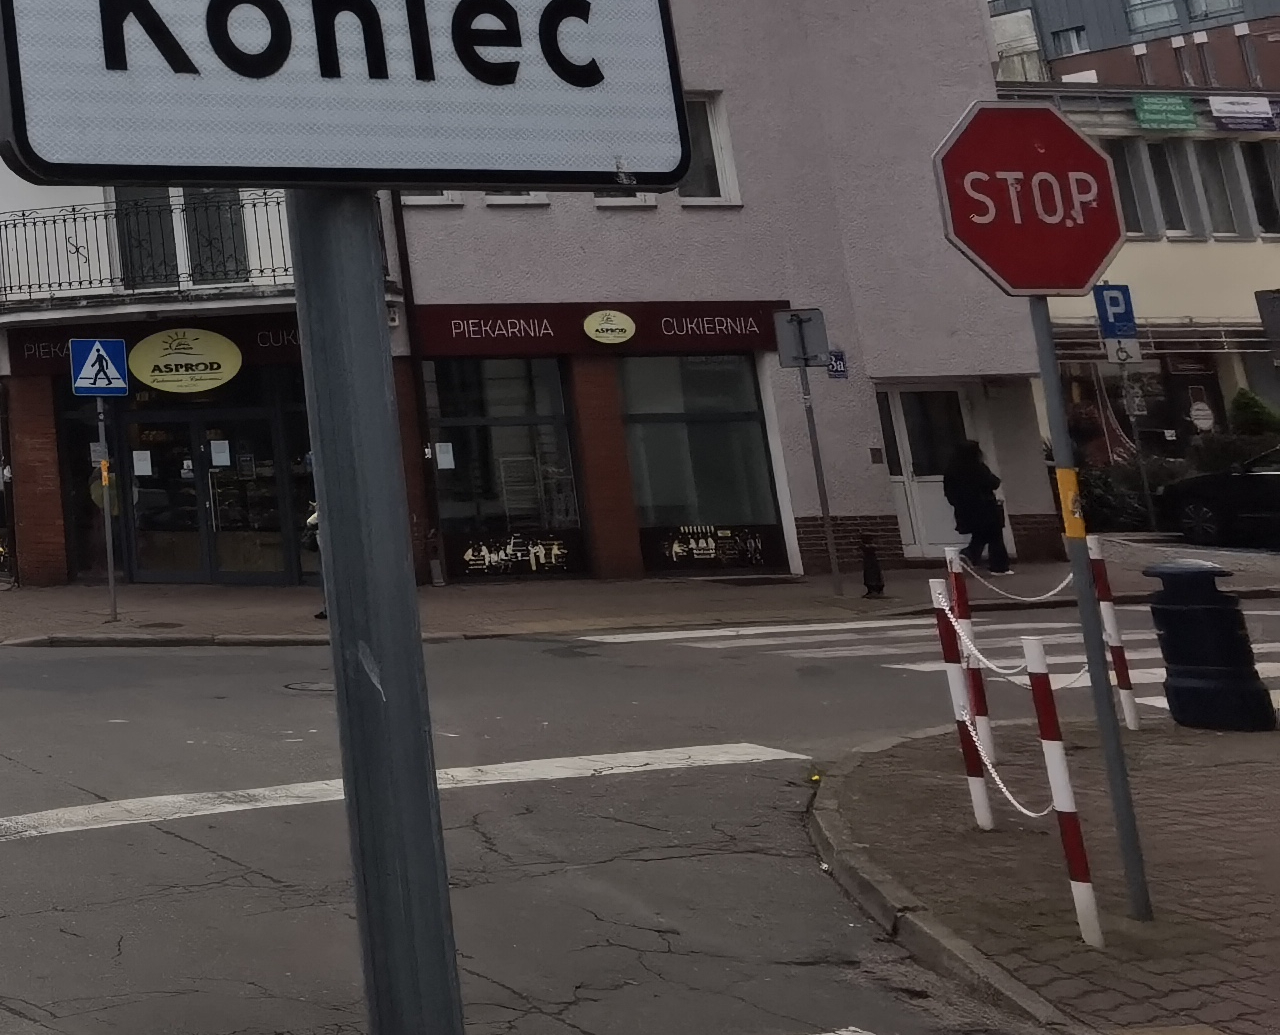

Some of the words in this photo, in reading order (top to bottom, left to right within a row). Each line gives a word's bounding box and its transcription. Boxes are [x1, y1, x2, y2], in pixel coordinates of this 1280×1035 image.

[962, 170, 1100, 226] STOP
[1103, 290, 1126, 323] P
[451, 318, 555, 339] PIEKARNIA
[660, 316, 760, 336] CUKIERNIA
[23, 342, 70, 359] PIEKA
[150, 361, 222, 374] ASPROD
